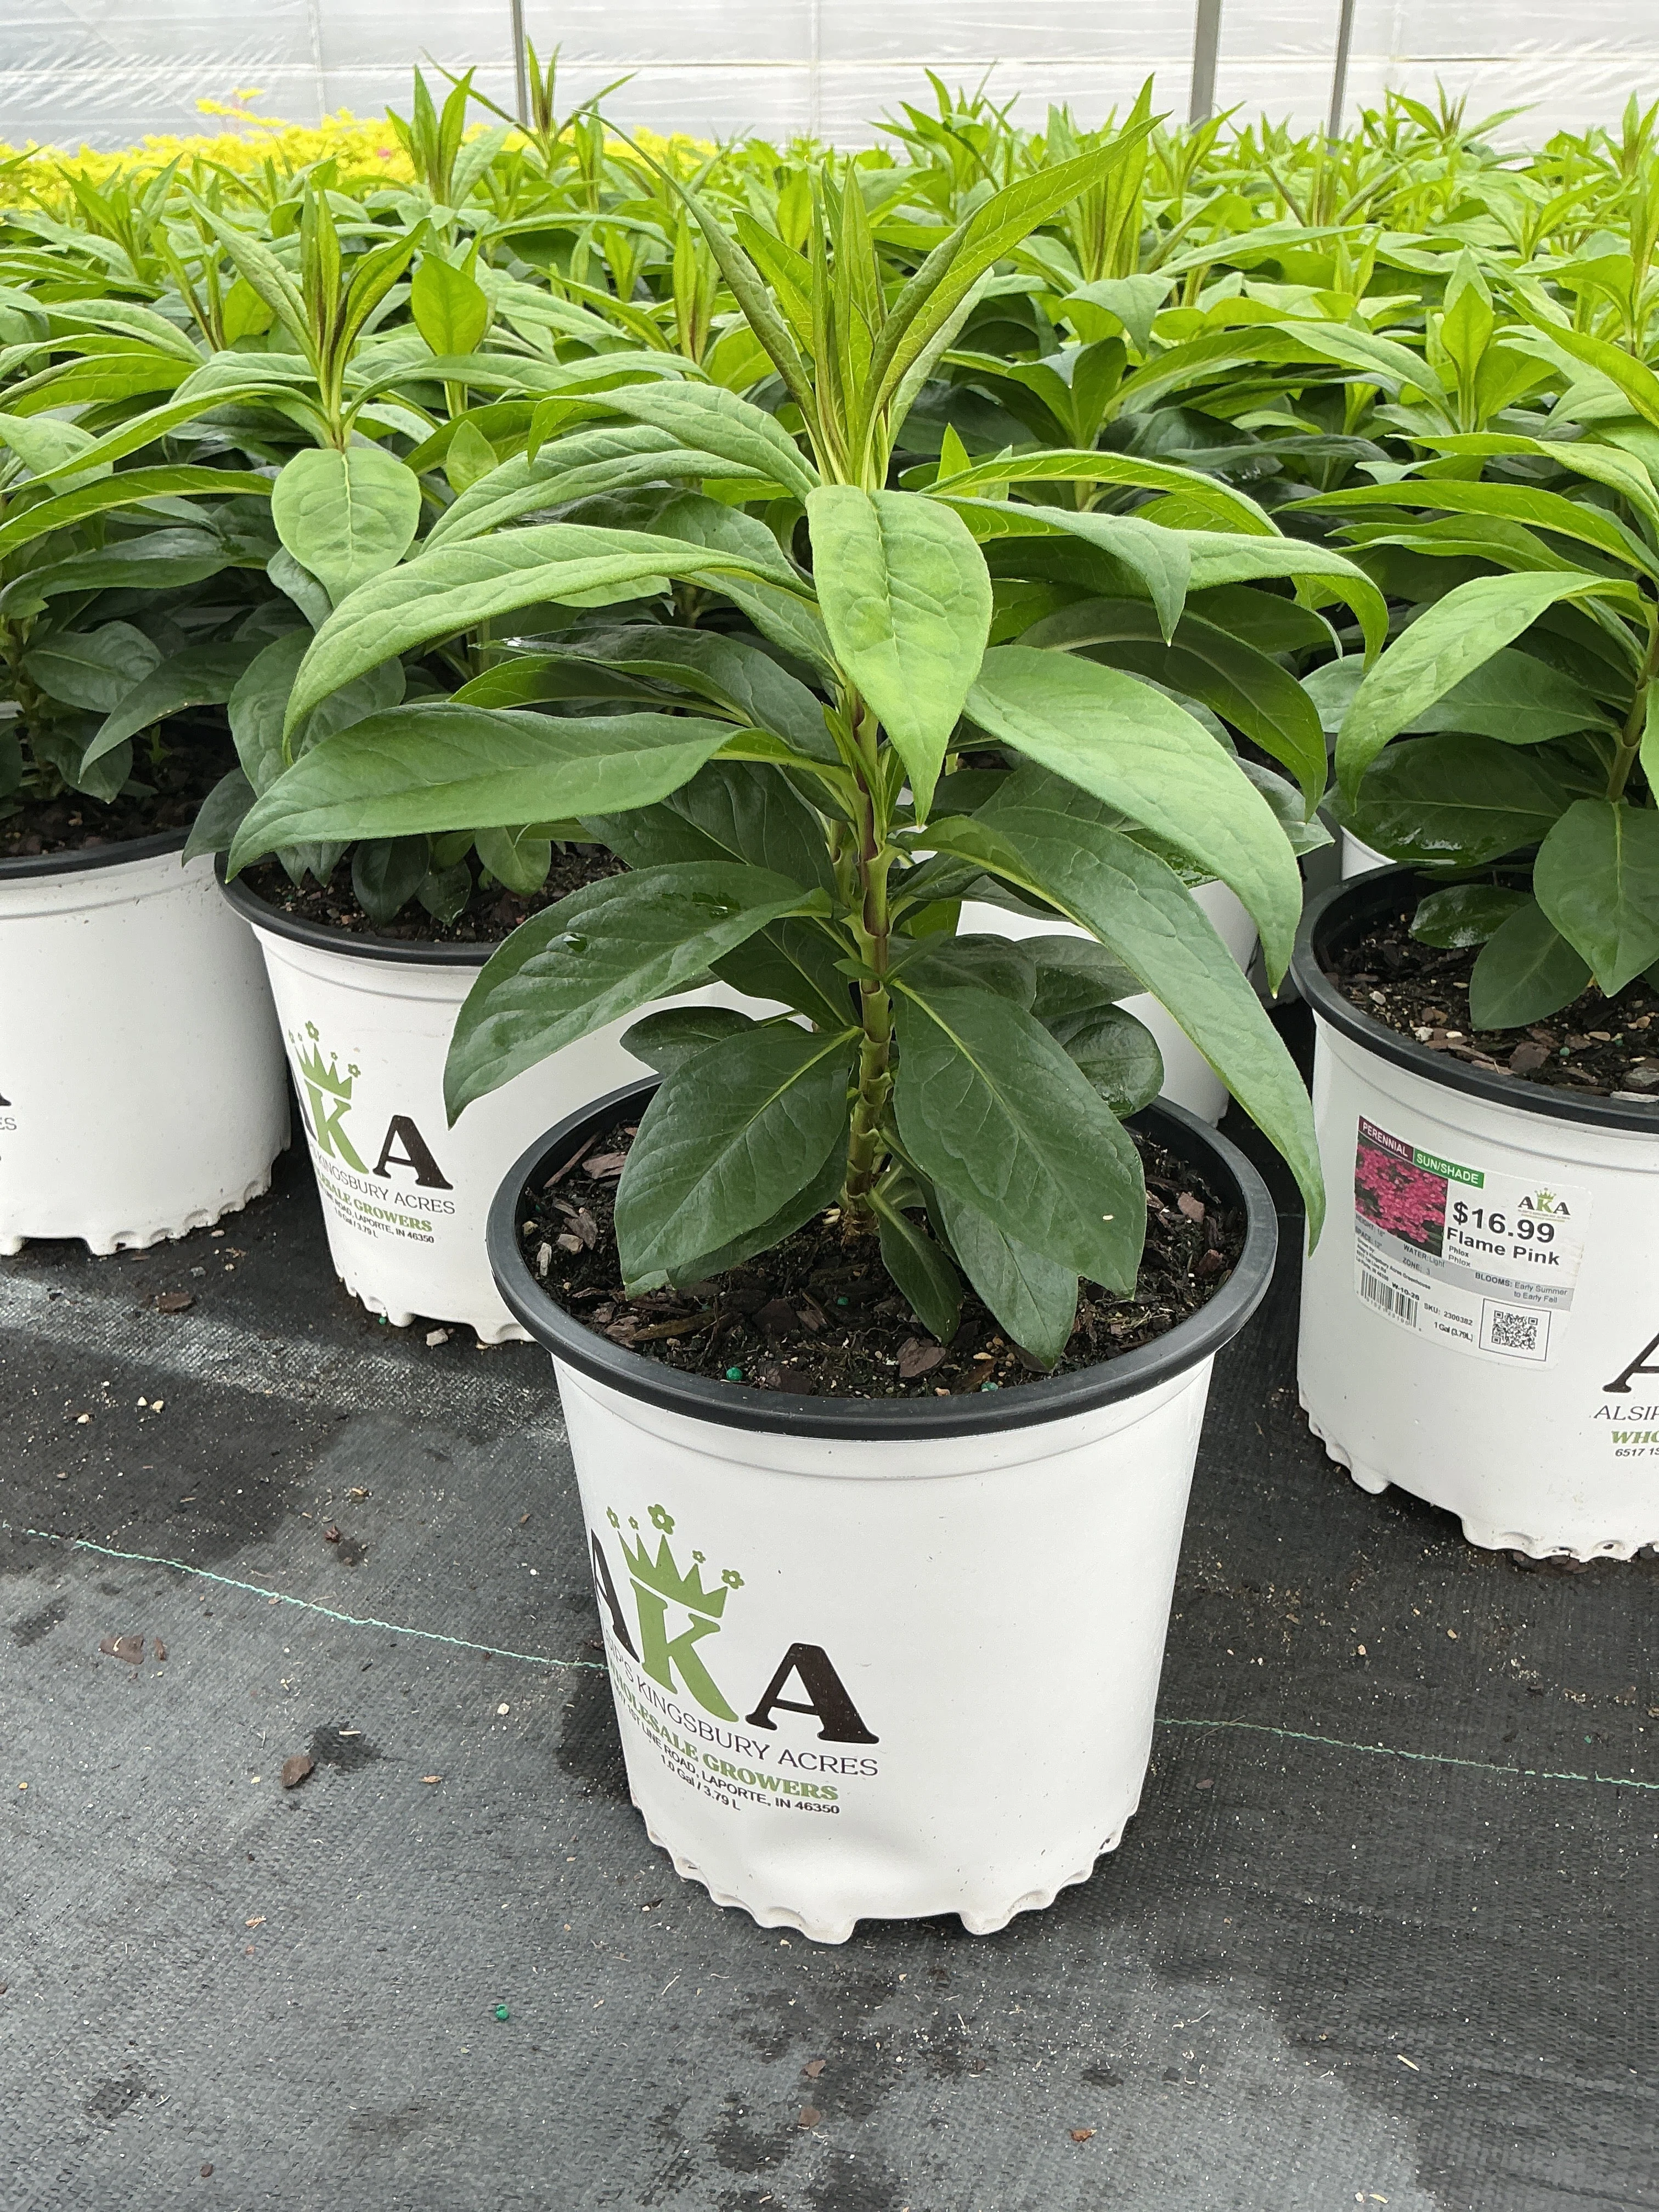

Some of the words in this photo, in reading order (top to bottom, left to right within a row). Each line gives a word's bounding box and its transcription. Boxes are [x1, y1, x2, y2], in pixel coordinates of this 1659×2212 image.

[291, 1064, 454, 1189] KA
[1363, 1121, 1408, 1158] PERENNIAL
[1417, 1154, 1479, 1184] SUN/SHADE
[354, 1199, 432, 1232] GROWERS
[394, 1192, 455, 1215] ACRES
[1517, 1195, 1571, 1216] AKA
[1452, 1200, 1555, 1243] $16.99
[396, 1228, 405, 1237] IN
[407, 1232, 435, 1244] 46350
[1447, 1227, 1506, 1255] Flame
[1513, 1245, 1560, 1266] Pink
[1448, 1254, 1471, 1267] Phlox
[1449, 1245, 1469, 1258] Phlox
[1475, 1272, 1513, 1288] BLOOMS:
[1515, 1282, 1533, 1293] Early
[1536, 1285, 1568, 1295] Summer
[1523, 1292, 1542, 1302] Early
[1544, 1295, 1558, 1304] Fall
[1424, 1302, 1441, 1315] SKU:
[1443, 1311, 1473, 1326] 2300382
[1615, 1448, 1645, 1457] 6517
[637, 1674, 770, 1760] KINGSBURY
[778, 1749, 878, 1776] ACRES
[642, 1722, 663, 1750] LINE
[775, 1797, 791, 1808] IN
[794, 1801, 840, 1814] 46350
[702, 1753, 839, 1801] GROWERS
[661, 1754, 675, 1772] 1.0
[677, 1768, 695, 1787] Gal
[703, 1785, 729, 1805] 3.79
[732, 1798, 741, 1811] L
